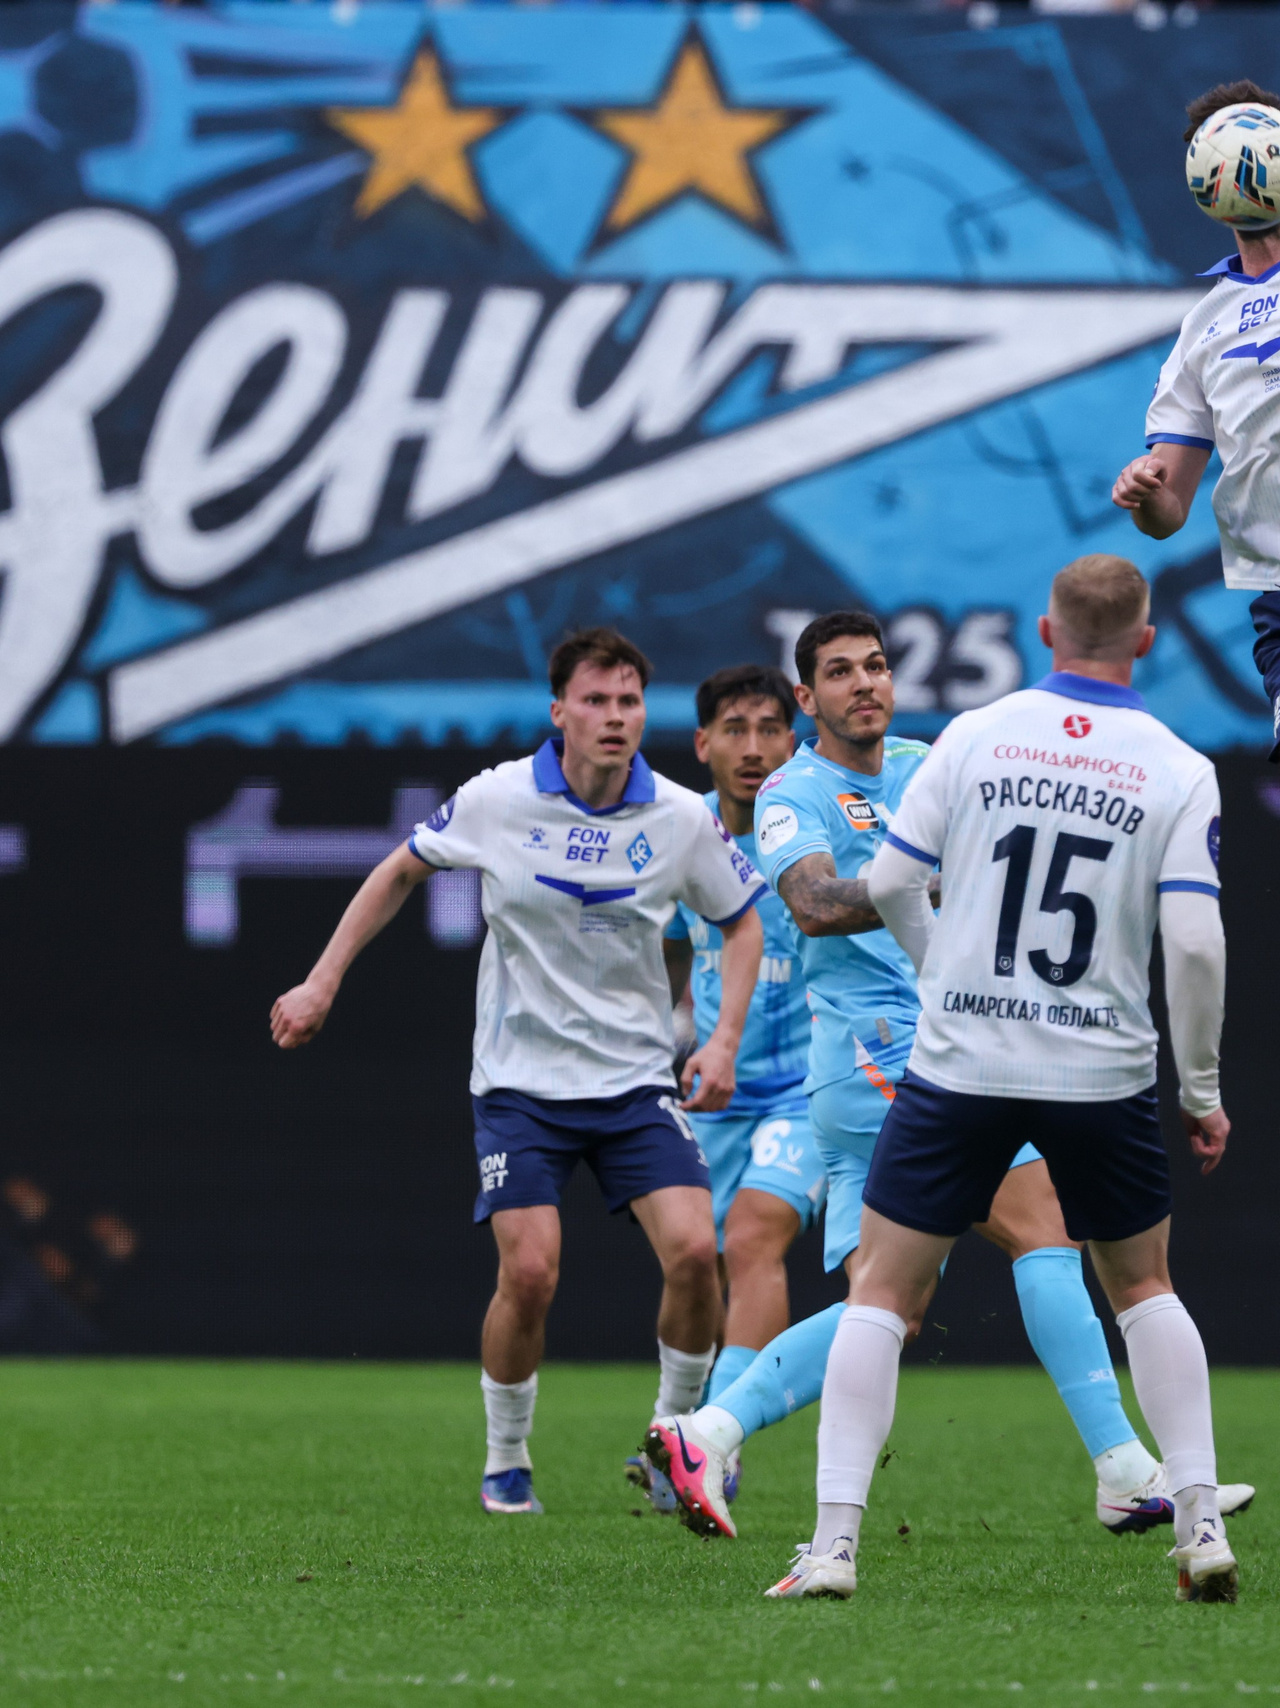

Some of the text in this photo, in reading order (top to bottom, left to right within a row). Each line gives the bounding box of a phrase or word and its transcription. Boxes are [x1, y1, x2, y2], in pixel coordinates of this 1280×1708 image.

[1238, 308, 1277, 334] BET
[1240, 294, 1279, 320] FON
[764, 609, 1023, 712] 125
[993, 744, 1147, 782] СОЛИДАРНОСТЬ
[979, 776, 1145, 835] РАССКАЗОВ
[1108, 779, 1142, 795] БАНК
[566, 846, 609, 863] BET
[568, 827, 610, 845] FON
[992, 824, 1114, 988] 15
[943, 990, 1120, 1028] САМАРСКАЯ ОБЛАСТЬ
[752, 1118, 792, 1167] 6
